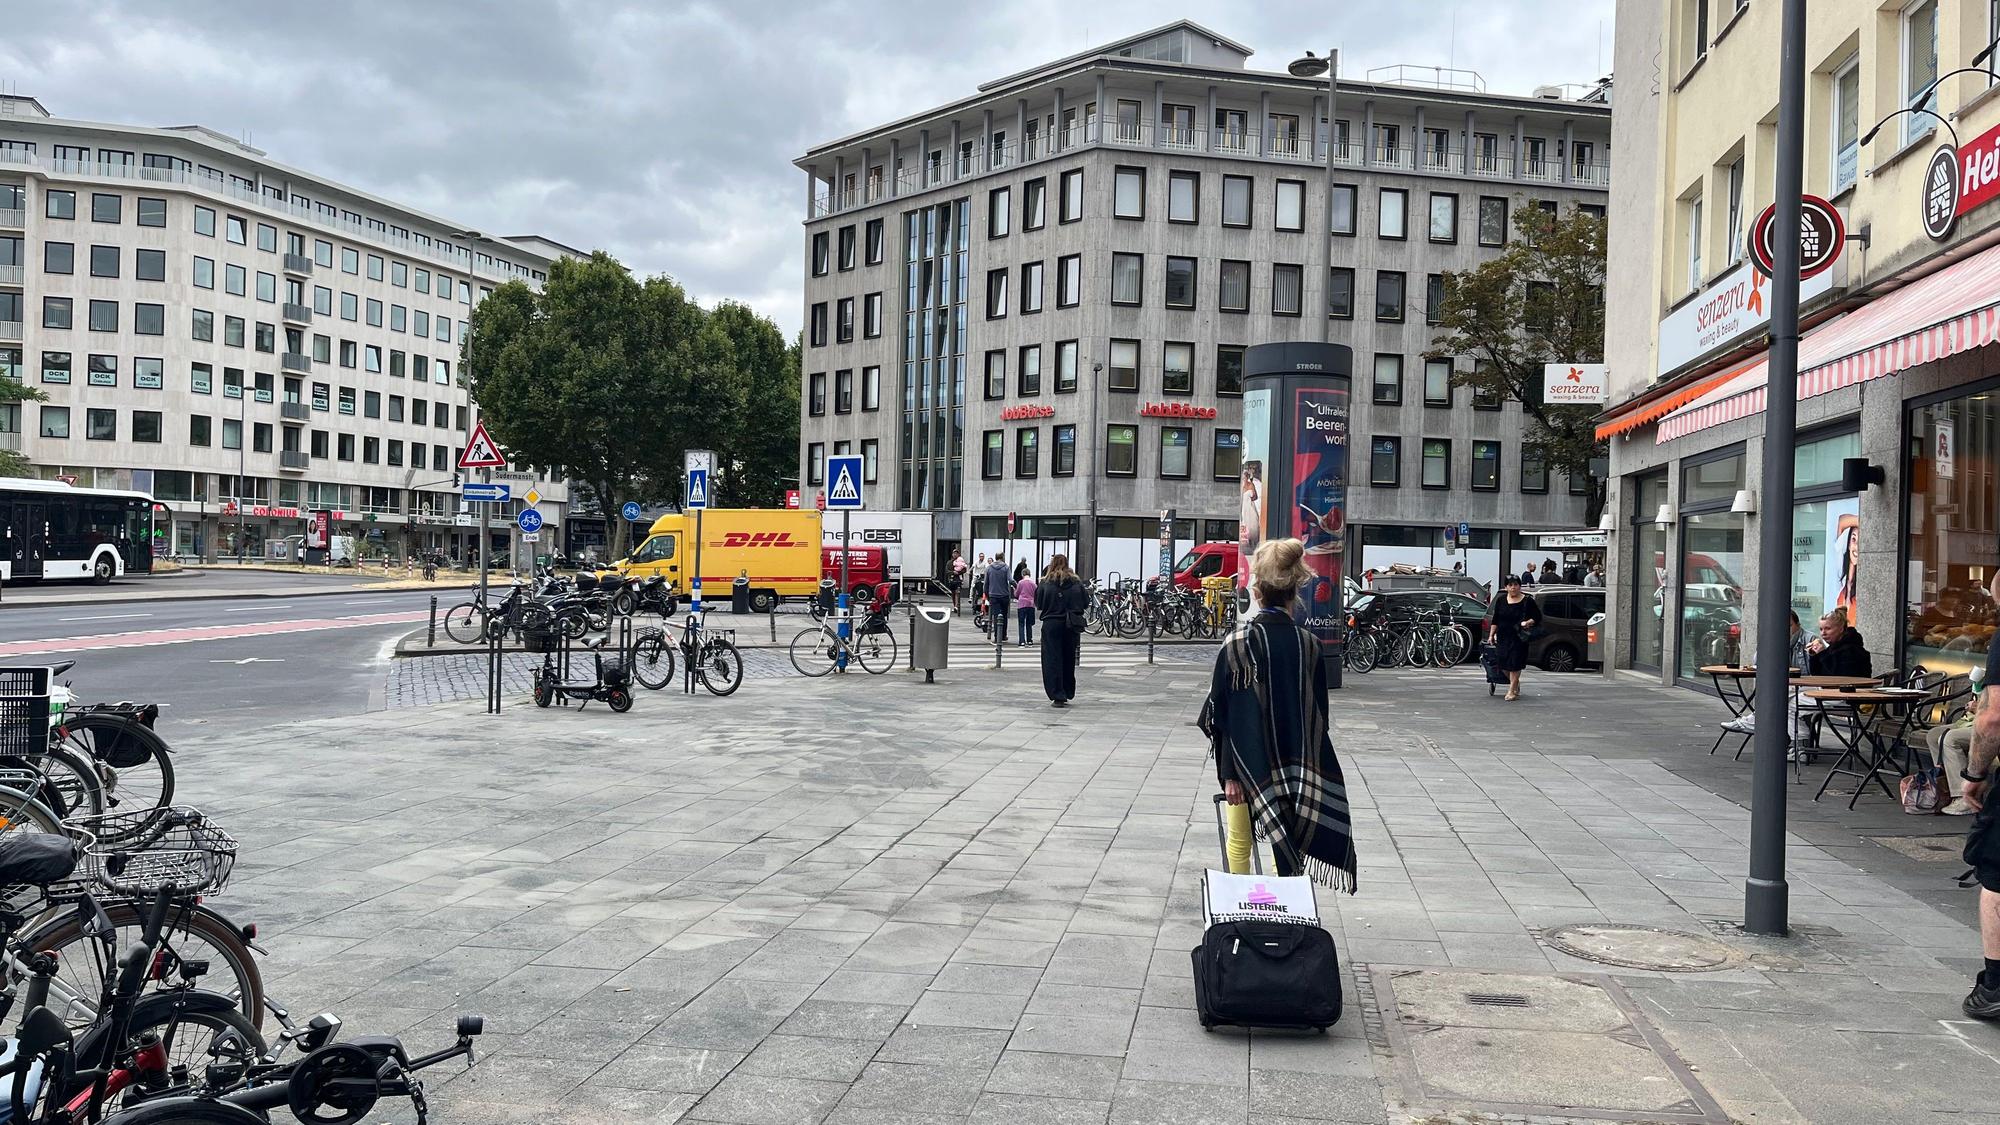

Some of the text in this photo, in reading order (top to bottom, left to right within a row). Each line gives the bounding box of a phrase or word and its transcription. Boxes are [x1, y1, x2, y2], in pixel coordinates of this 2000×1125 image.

[1697, 281, 1745, 333] senzera
[1550, 385, 1600, 394] senzera
[1000, 405, 1054, 420] JobBörse
[1141, 402, 1217, 419] JobBörse
[723, 532, 795, 548] DHL
[1239, 902, 1288, 913] LISTERINE
